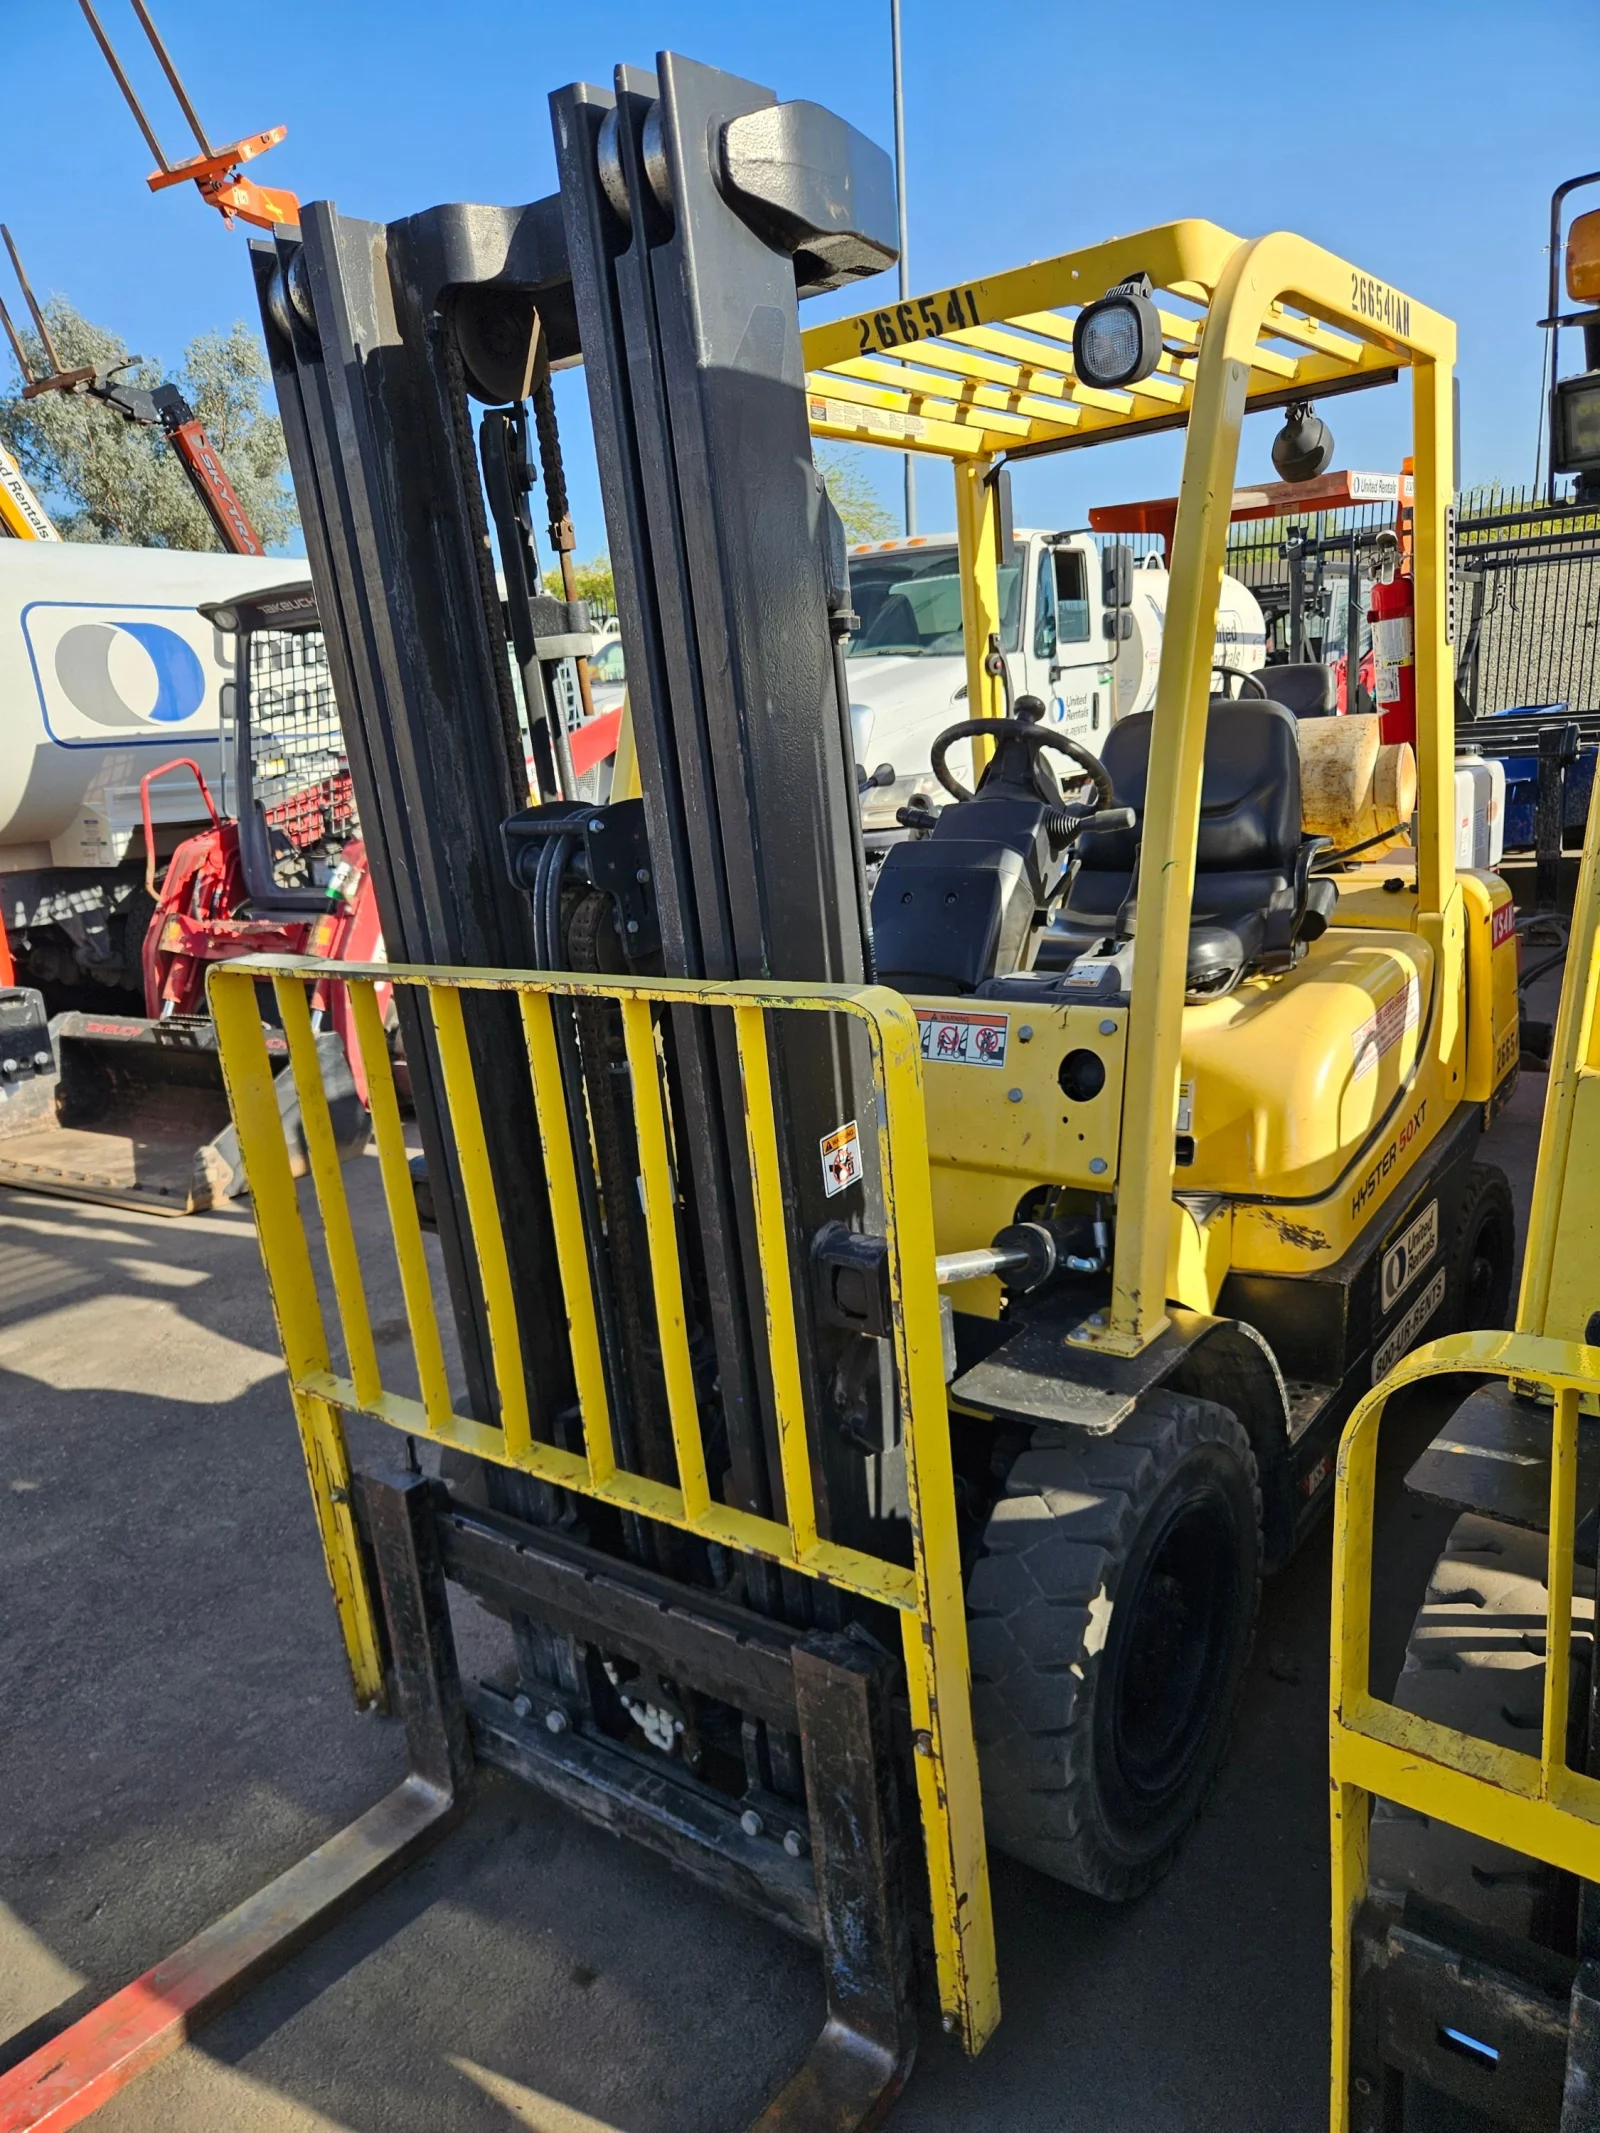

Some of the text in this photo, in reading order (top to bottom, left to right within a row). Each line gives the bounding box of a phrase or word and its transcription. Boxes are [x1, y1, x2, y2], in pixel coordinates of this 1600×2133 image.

[853, 289, 980, 355] 266541
[200, 452, 256, 555] SKYTRA
[1361, 478, 1378, 493] United
[1379, 480, 1397, 494] Rentals
[8, 480, 50, 539] Rentals
[1066, 693, 1088, 708] United
[1066, 708, 1089, 721] Rentals
[940, 1015, 970, 1023] WARNING
[1351, 1098, 1427, 1221] HYSTER 50XT
[1407, 1210, 1434, 1255] United
[1407, 1233, 1435, 1277] Rentals
[1375, 1278, 1442, 1380] 800-UR-RENTS
